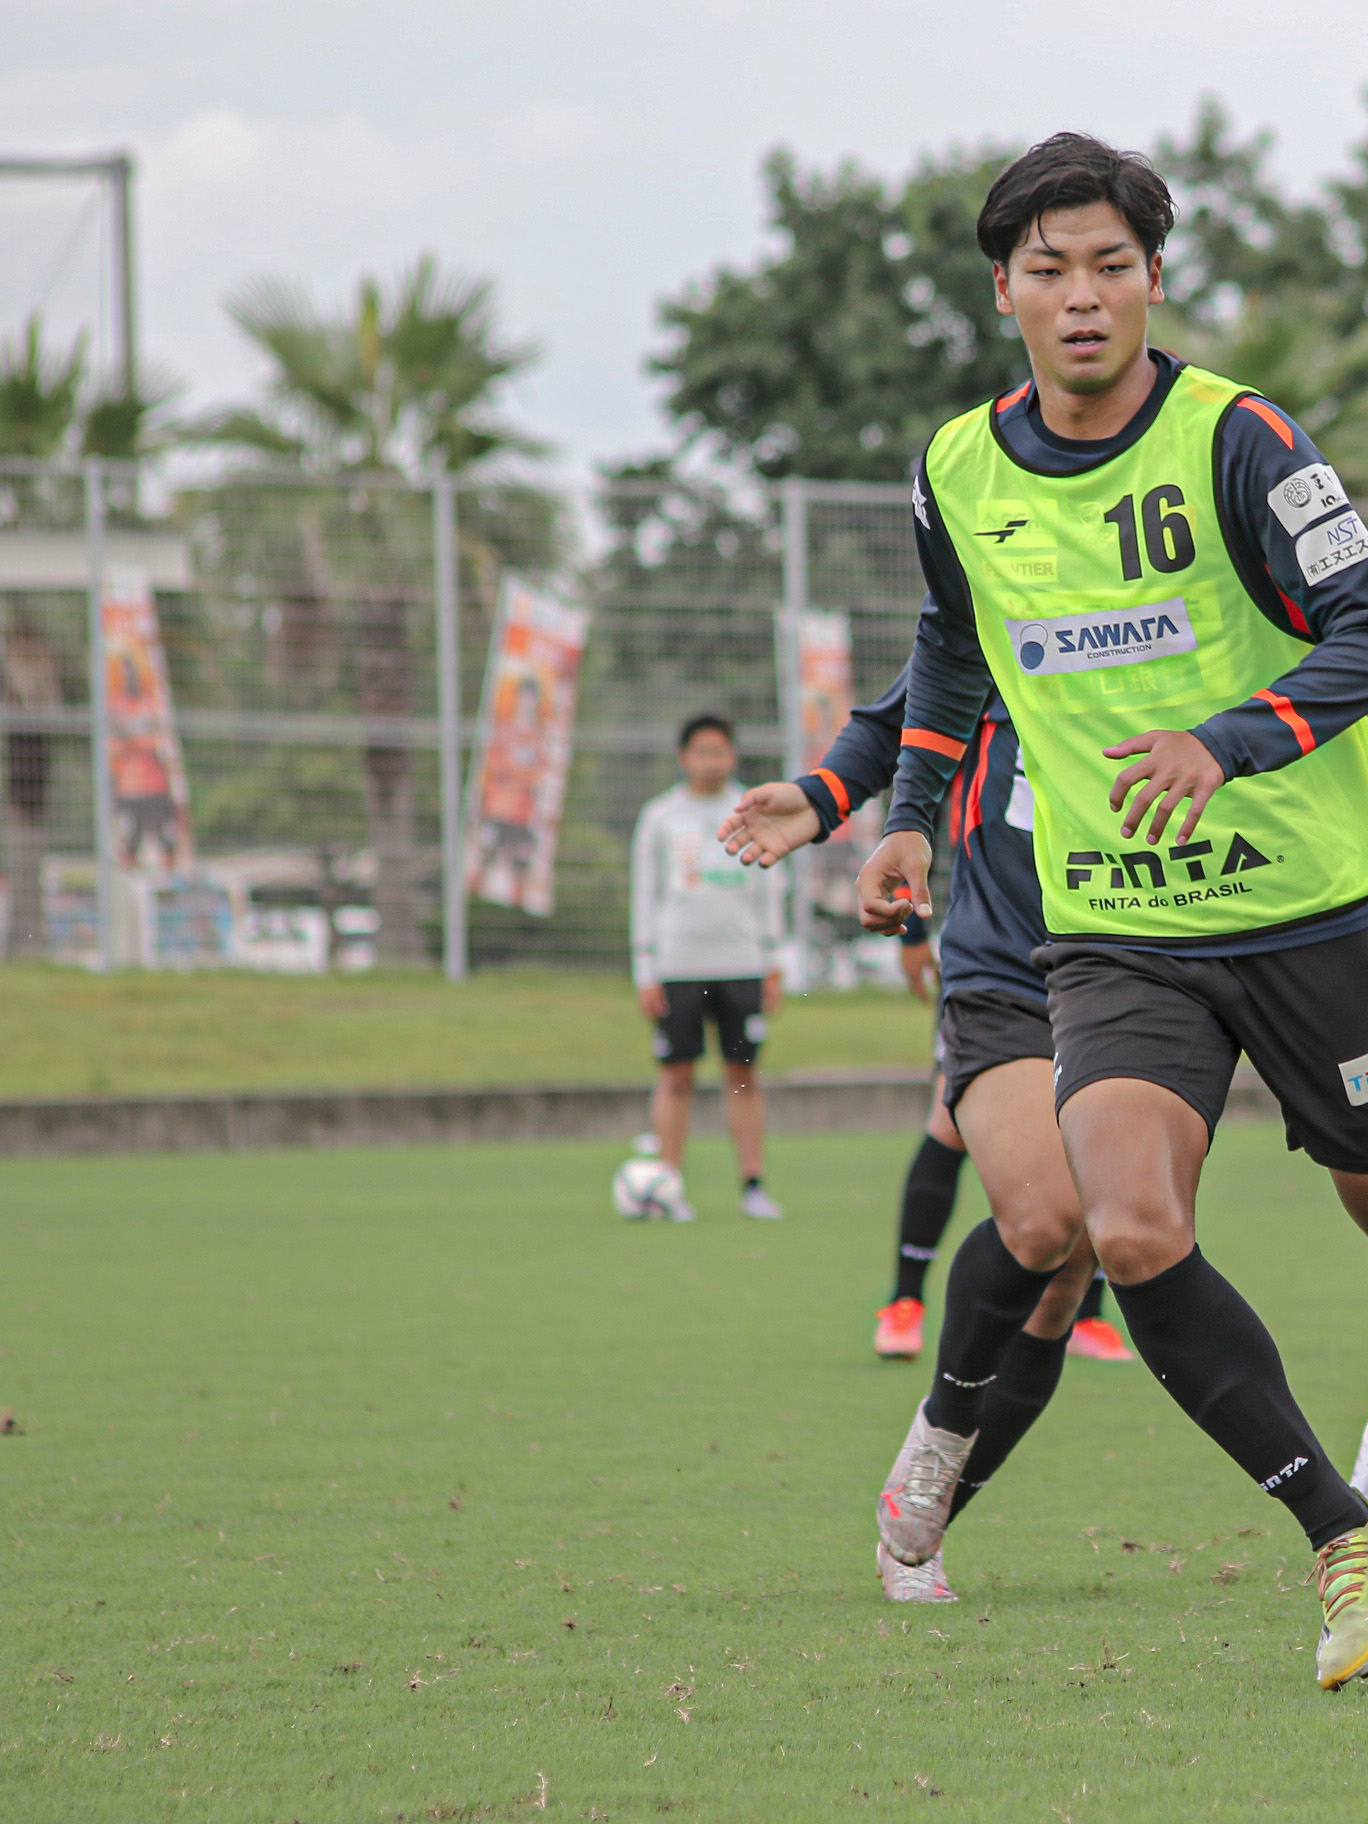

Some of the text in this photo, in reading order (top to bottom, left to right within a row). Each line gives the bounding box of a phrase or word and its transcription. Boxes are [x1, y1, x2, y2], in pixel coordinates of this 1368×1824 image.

[1104, 484, 1197, 582] 16
[1326, 516, 1358, 546] NST
[1055, 614, 1180, 654] SAWATA
[1087, 643, 1153, 660] CONSTRUCTION
[1089, 881, 1253, 911] FINTA do BRASIL
